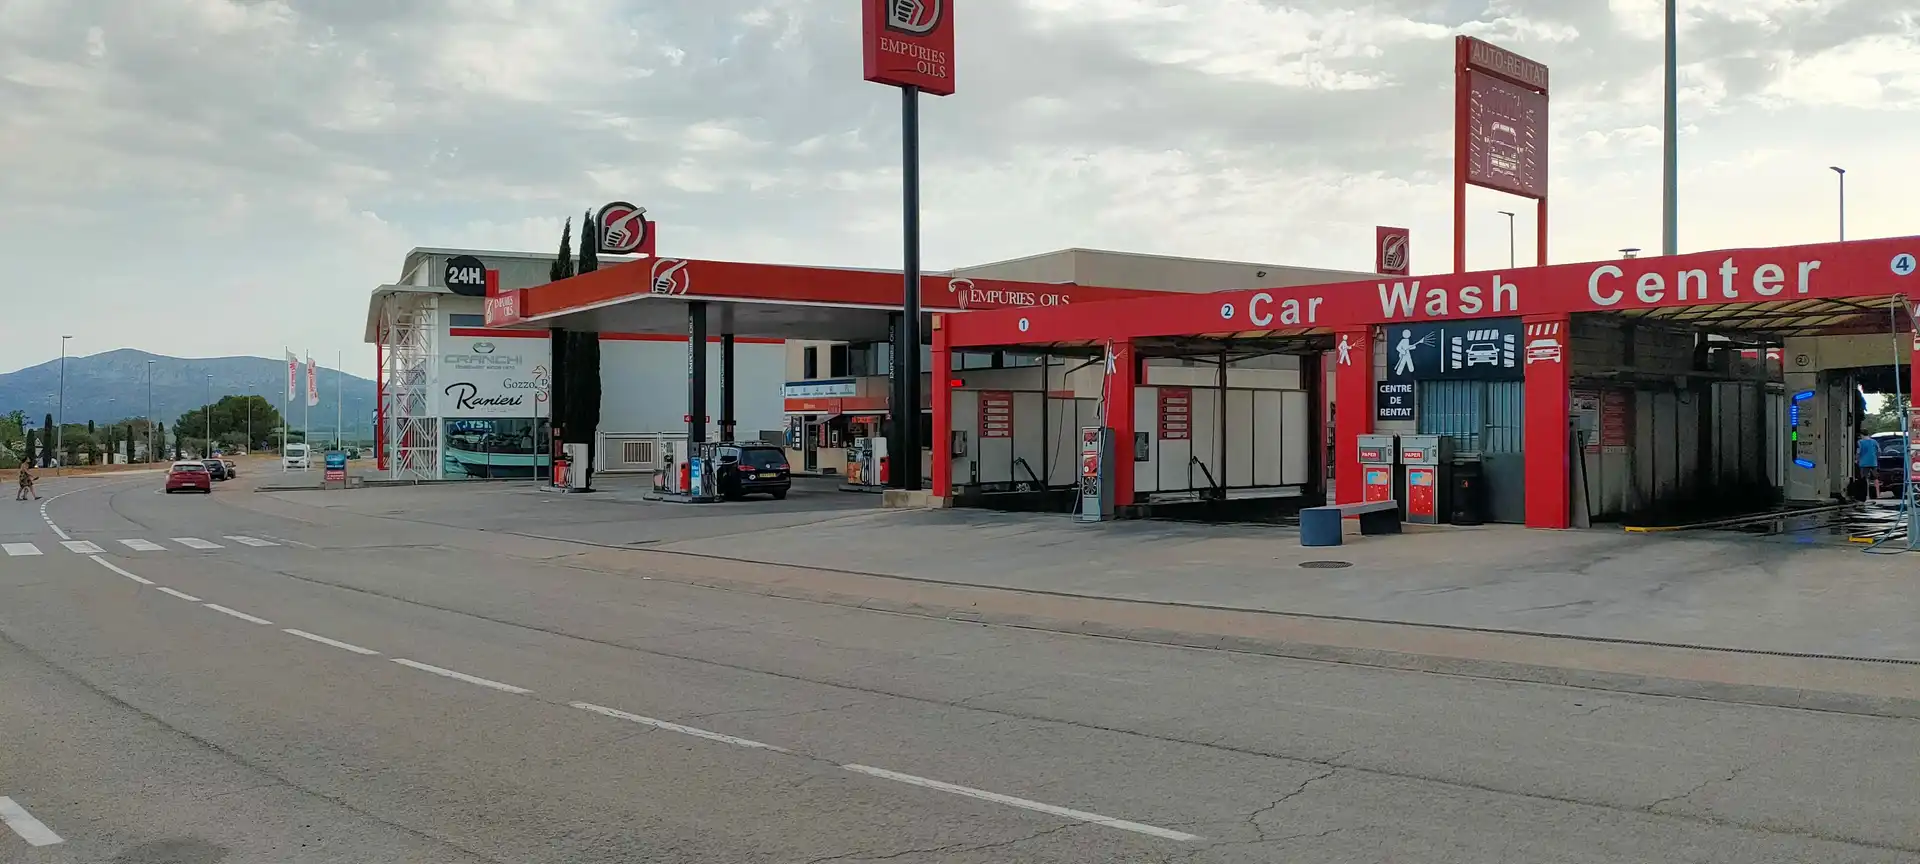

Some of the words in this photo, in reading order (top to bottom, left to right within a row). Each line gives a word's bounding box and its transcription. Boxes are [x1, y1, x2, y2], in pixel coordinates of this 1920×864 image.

[880, 37, 945, 65] EMPÚRIES
[917, 61, 946, 78] OILS
[1896, 256, 1908, 271] 4
[970, 287, 1035, 306] EMPÚRIES
[1249, 292, 1323, 326] Car
[1377, 274, 1518, 318] Wash
[1588, 257, 1821, 305] Center
[1224, 305, 1231, 317] 2
[444, 354, 523, 366] CRANCHI
[444, 382, 523, 410] Ranieri
[1380, 384, 1412, 393] CENTRE
[1390, 396, 1402, 405] DE
[1380, 408, 1412, 416] RENTAT
